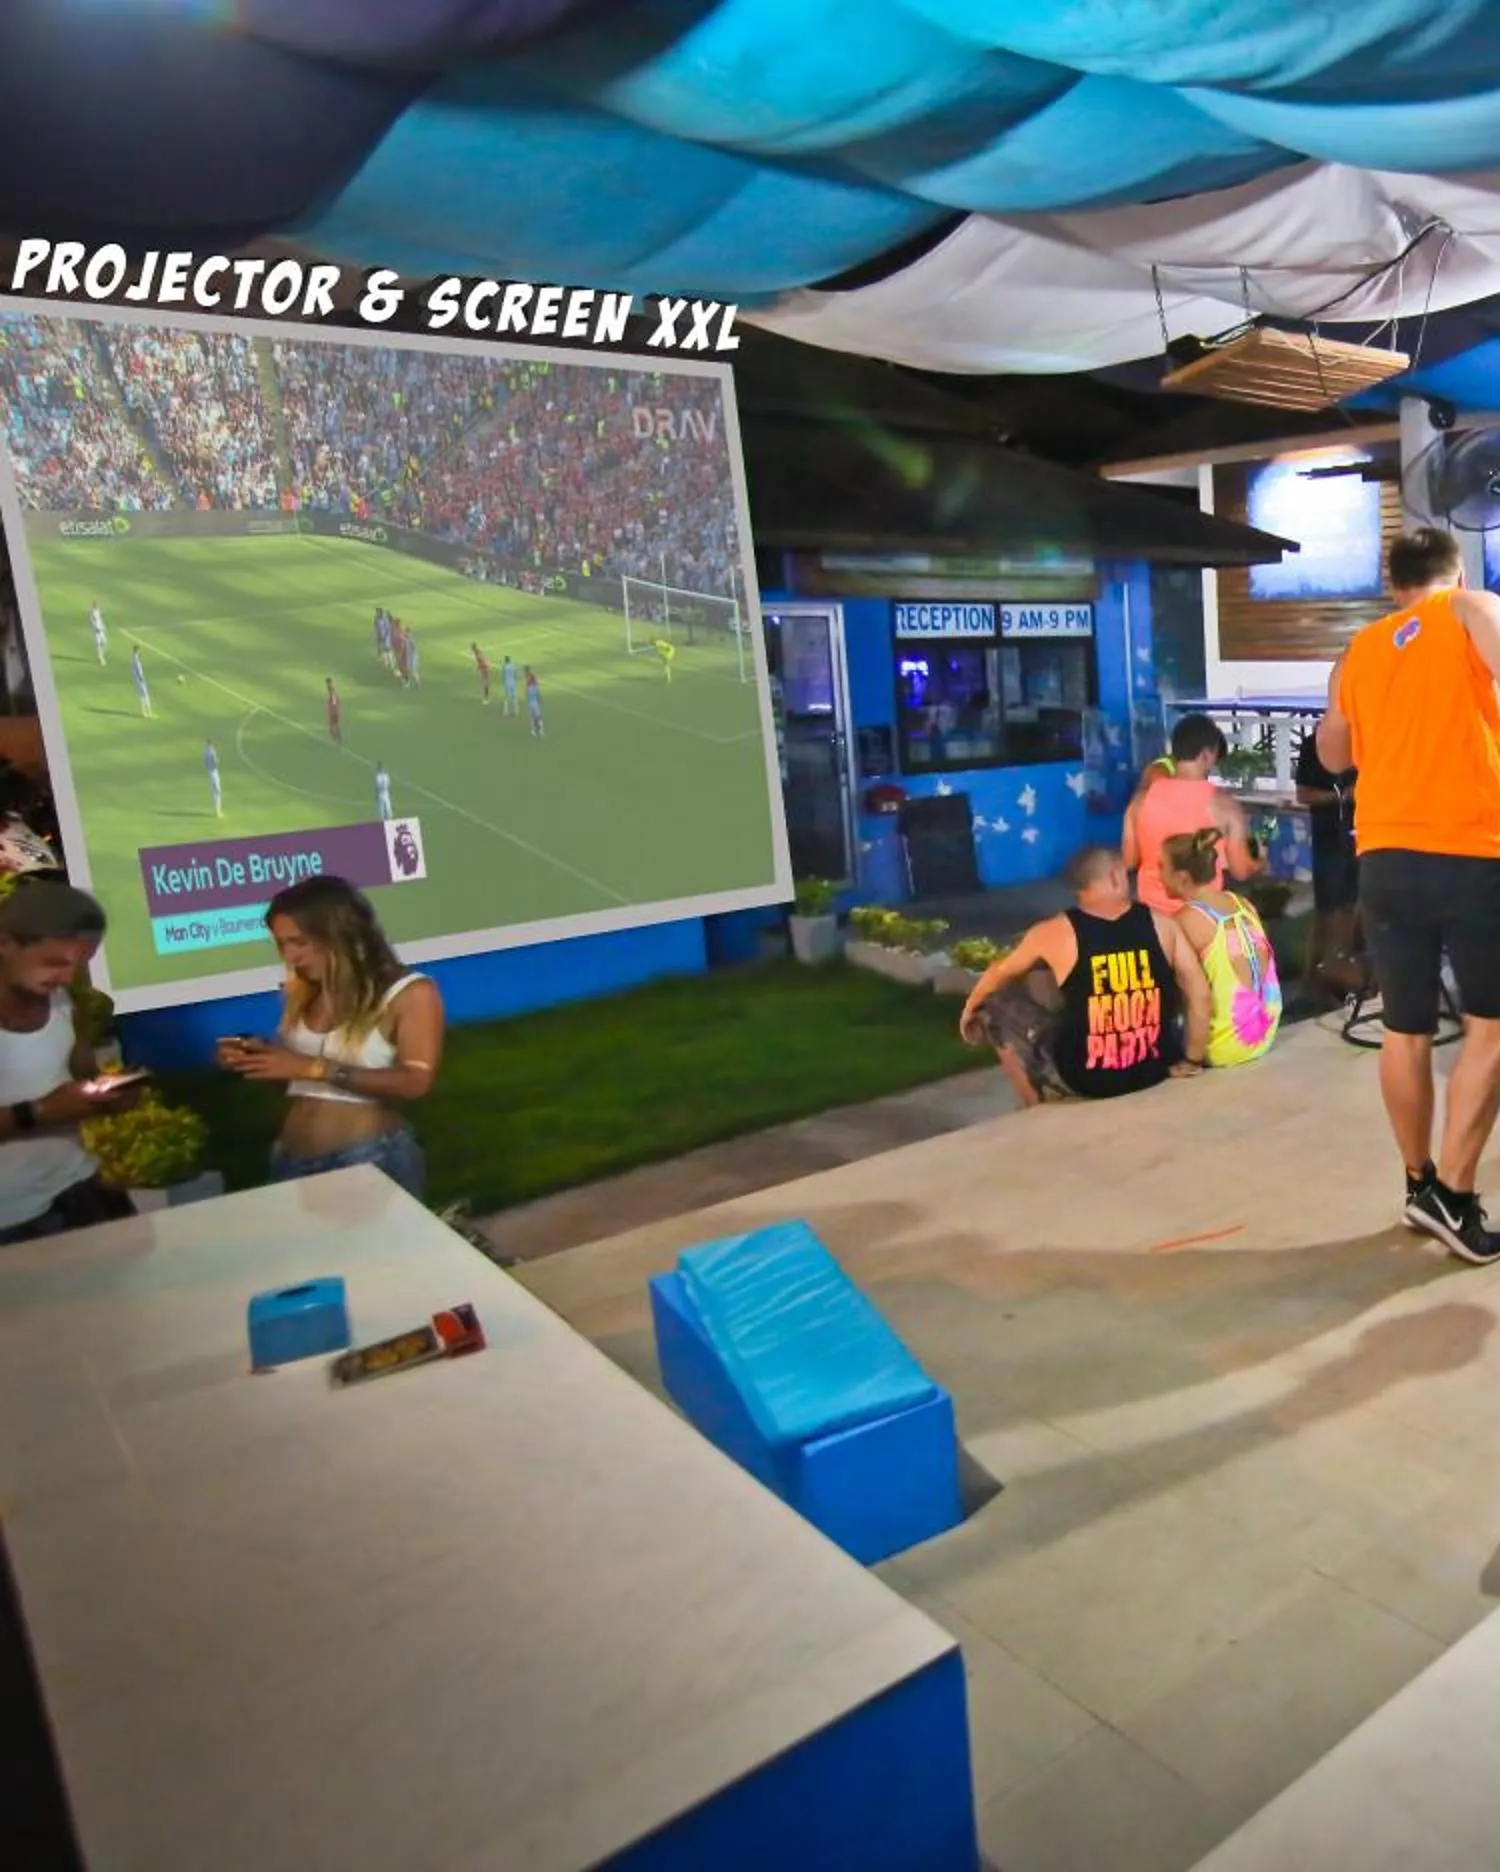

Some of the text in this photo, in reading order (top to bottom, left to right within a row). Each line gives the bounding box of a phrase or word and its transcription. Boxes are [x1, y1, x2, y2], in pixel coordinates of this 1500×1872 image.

[1002, 611, 1012, 630] 9
[1065, 609, 1089, 629] PM
[151, 851, 323, 896] Kevin De Bruyne
[165, 926, 188, 943] Man
[190, 922, 211, 944] City
[1091, 949, 1155, 995] FULL
[1088, 987, 1160, 1035] MOON
[1086, 1023, 1160, 1070] PARTY
